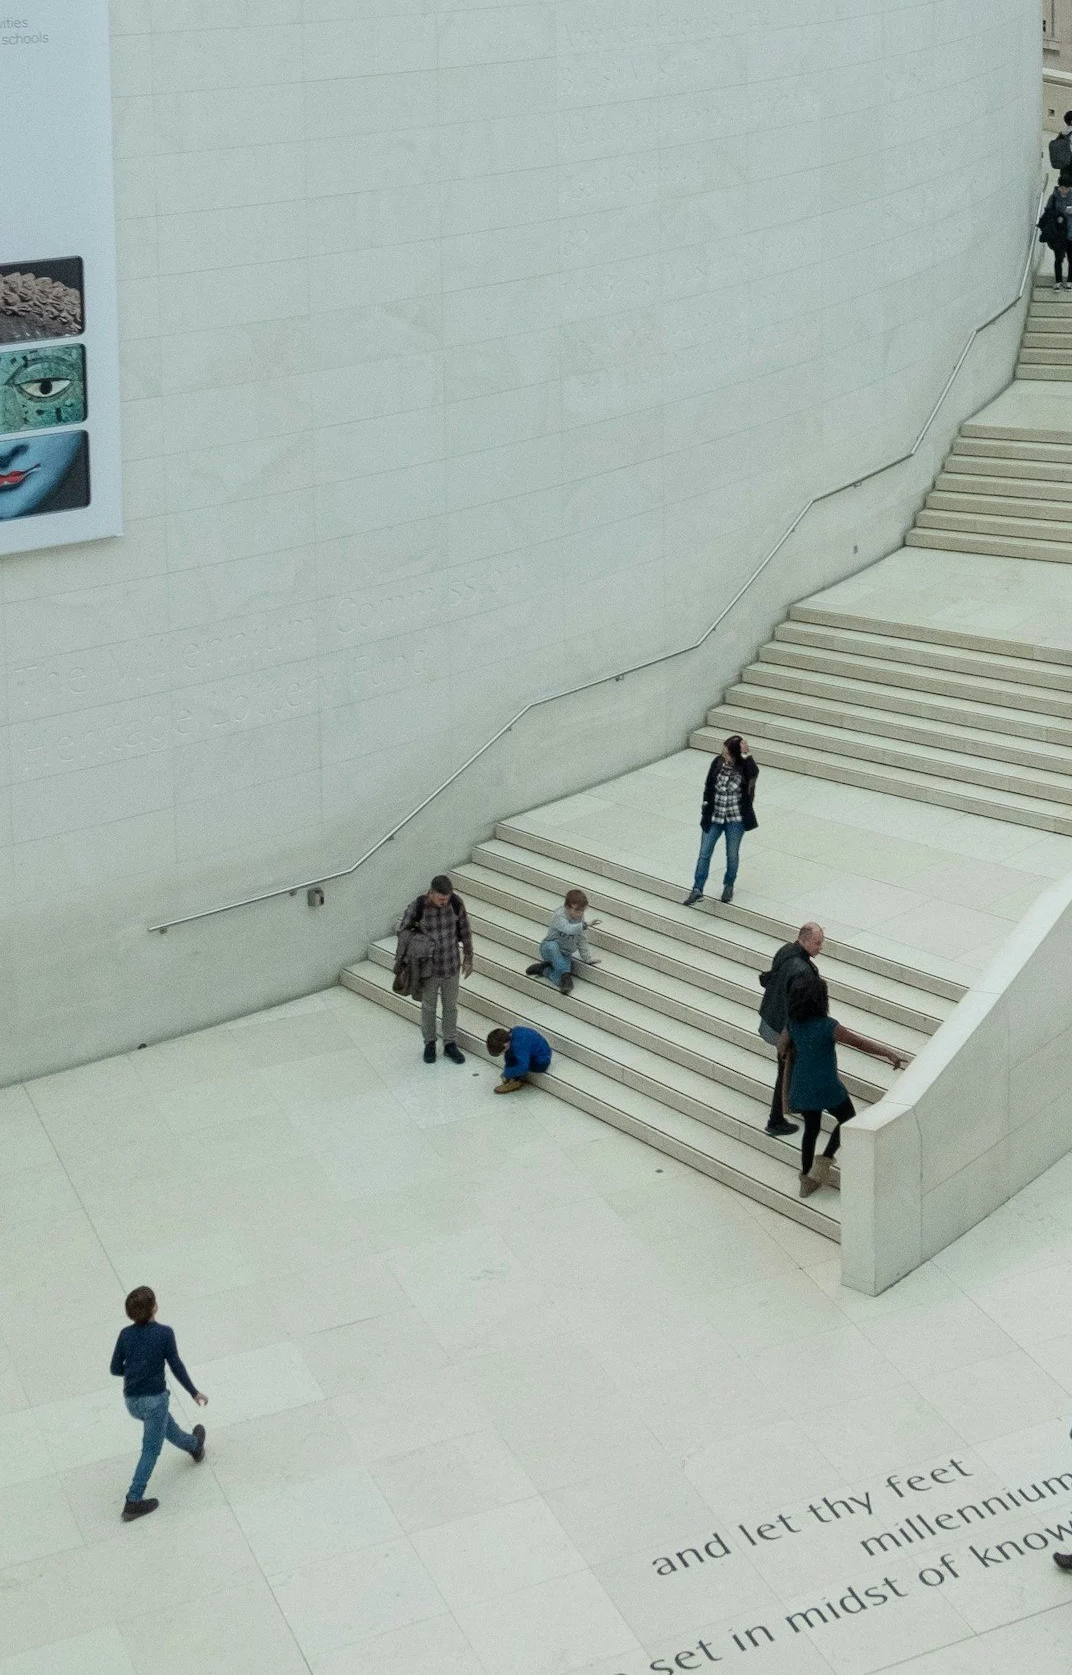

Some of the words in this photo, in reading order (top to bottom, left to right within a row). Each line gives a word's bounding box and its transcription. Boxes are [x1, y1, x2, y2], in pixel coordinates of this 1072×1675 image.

[2, 31, 49, 45] schools
[652, 1533, 731, 1575] and
[739, 1514, 803, 1546] let
[806, 1492, 875, 1523] thy
[886, 1457, 974, 1498] feet
[650, 1639, 724, 1675] set
[728, 1625, 775, 1651] in
[785, 1575, 910, 1633] midst
[918, 1553, 961, 1587] of
